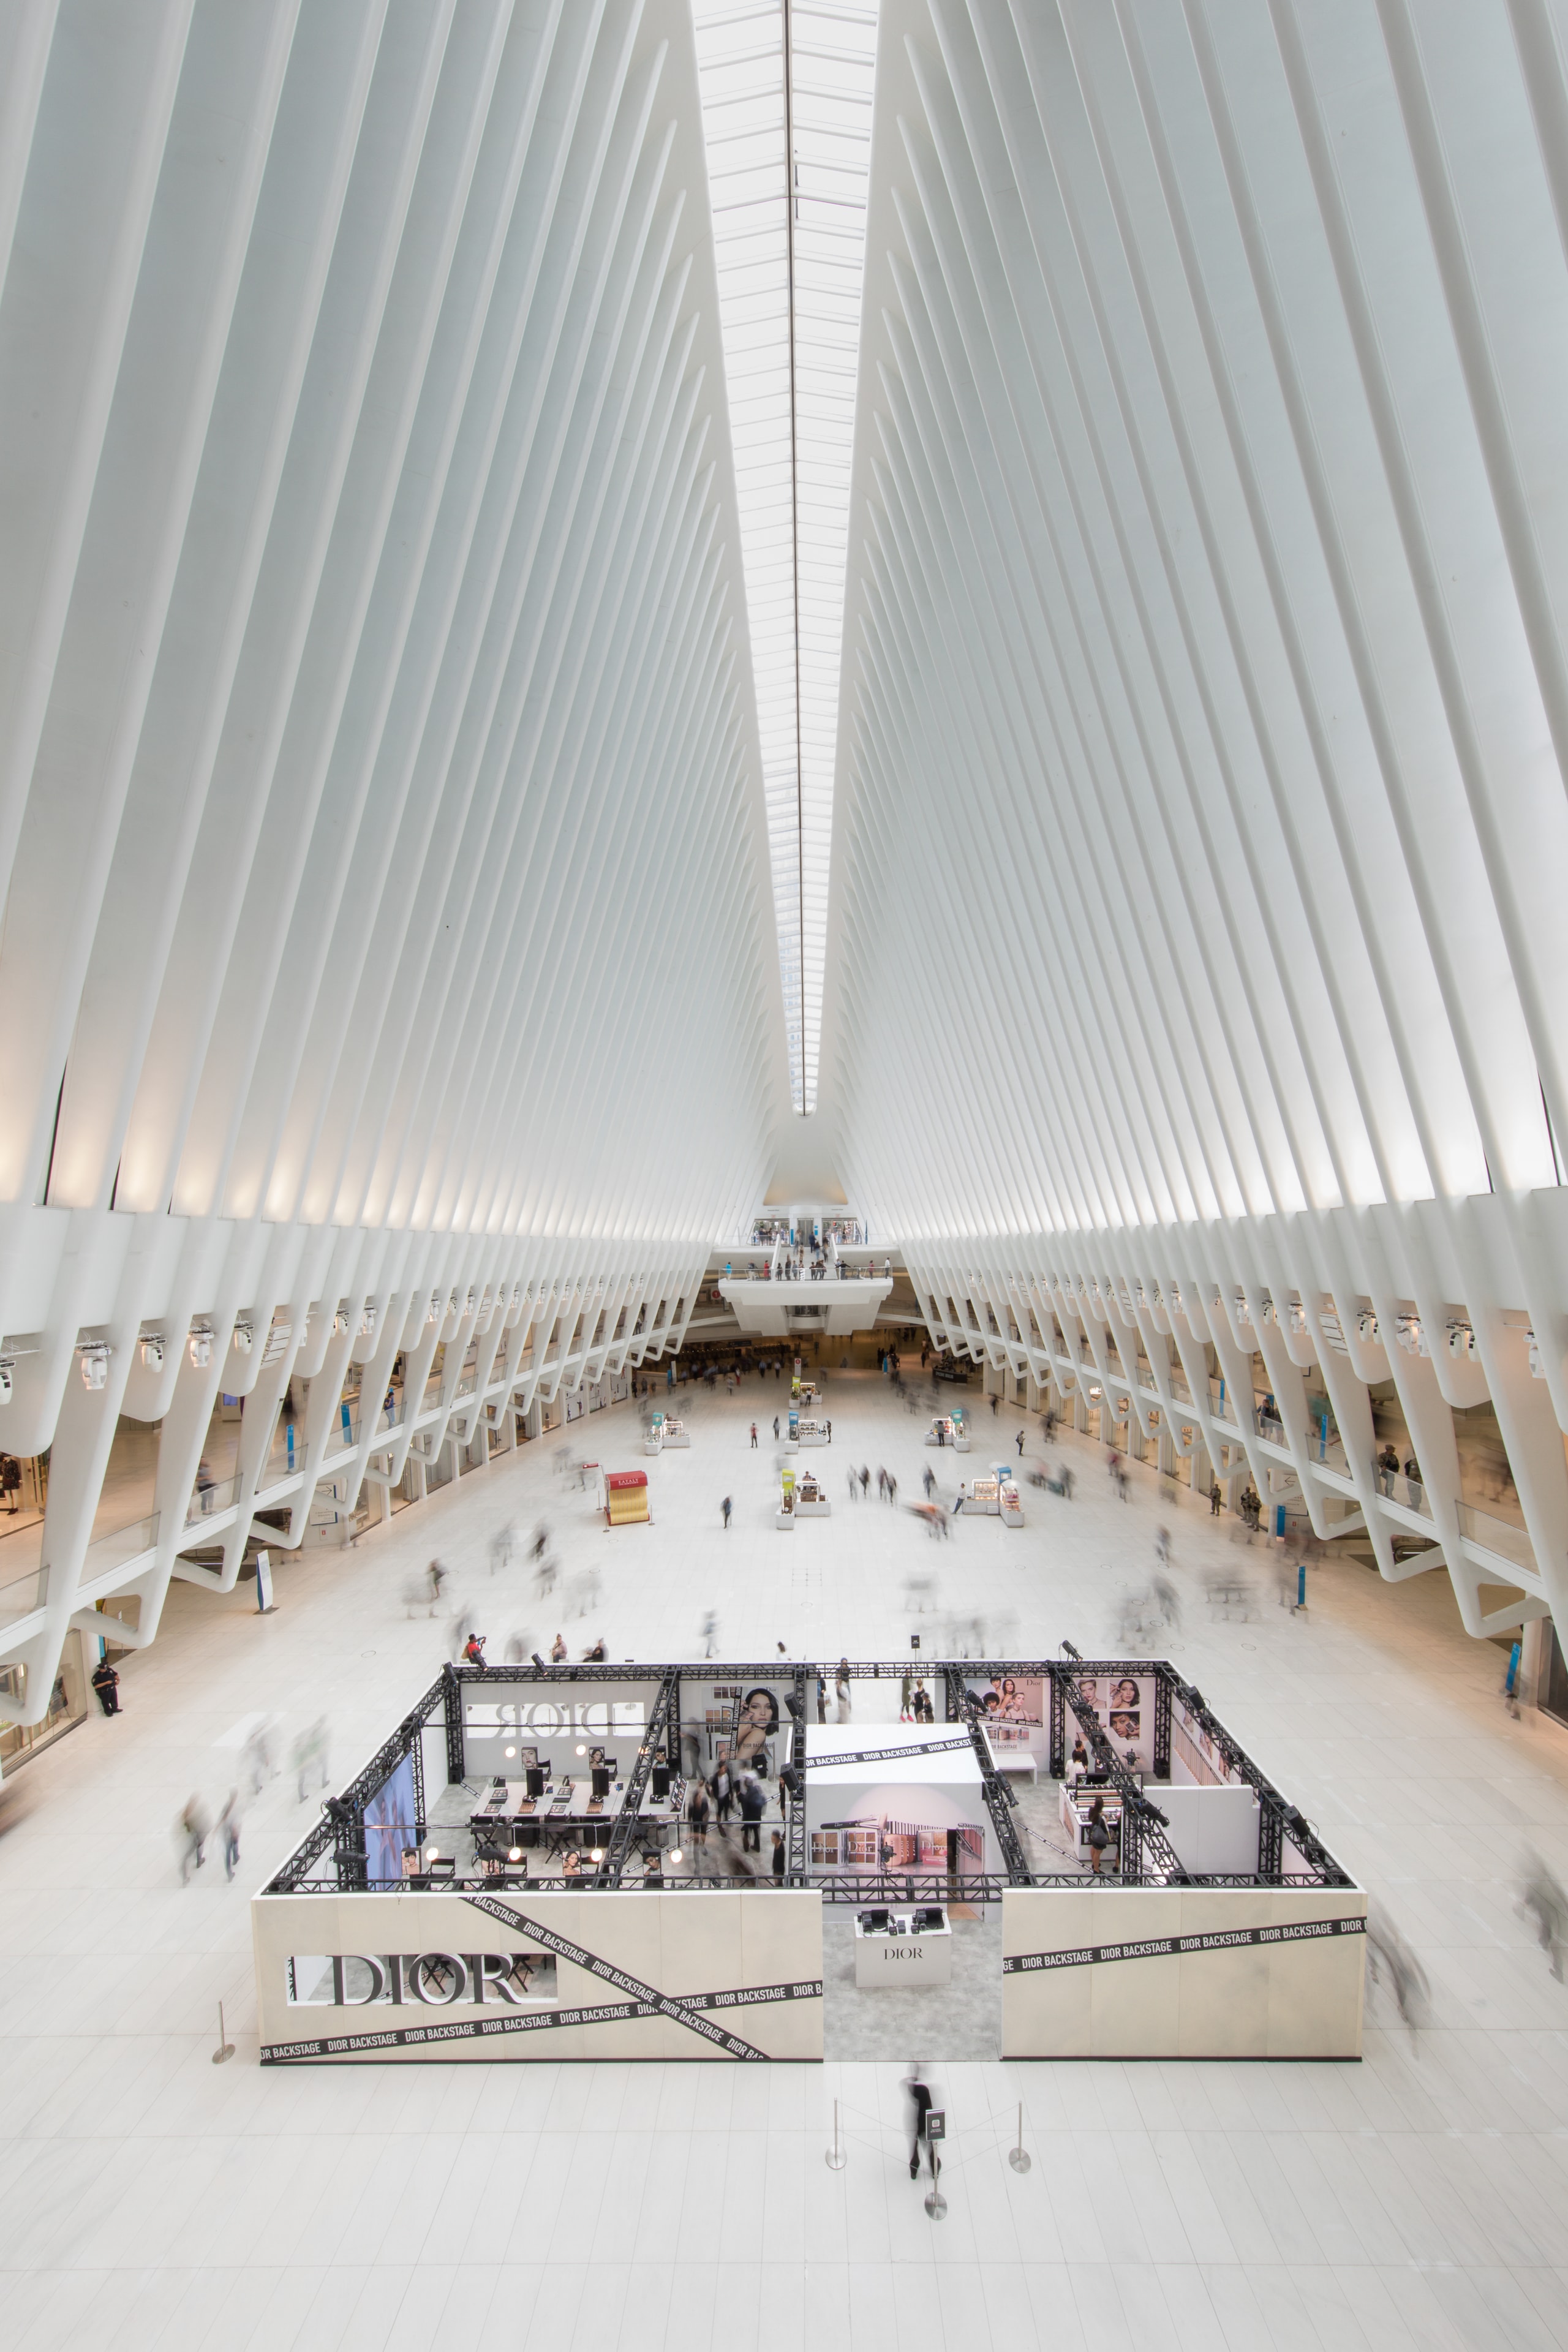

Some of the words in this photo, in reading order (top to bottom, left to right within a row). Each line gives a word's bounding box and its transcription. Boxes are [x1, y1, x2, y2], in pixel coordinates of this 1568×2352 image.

[816, 1755, 858, 1765] BACKSTAGE
[882, 1746, 923, 1758] BACKSTAGE
[813, 1841, 834, 1853] Dior
[848, 1841, 872, 1852] Dior
[922, 1841, 944, 1850] Dior
[884, 1948, 923, 1960] DIOR
[1022, 1958, 1042, 1969] DIOR
[1044, 1951, 1093, 1967] BACKSTAGE
[1101, 1948, 1121, 1960] DIOR
[1123, 1941, 1172, 1956] BACKSTAGE
[1180, 1938, 1201, 1950] DIOR
[1203, 1932, 1252, 1947] BACKSTAGE
[1259, 1929, 1281, 1941] DIOR
[1283, 1923, 1332, 1939] BACKSTAGE
[1341, 1920, 1362, 1932] DIOR
[325, 1953, 522, 2006] DIOR
[474, 1896, 520, 1926] BACKSTAGE
[523, 1921, 545, 1940] DIOR
[543, 1933, 589, 1964] BACKSTAGE
[592, 1961, 613, 1978] DIOR
[611, 1971, 657, 2003] BACKSTAGE
[659, 1999, 680, 2017] DIOR
[679, 2010, 724, 2042] BACKSTAGE
[726, 2038, 748, 2056] DIOR
[273, 2043, 321, 2058] BACKSTAGE
[328, 2040, 349, 2051] DIOR
[350, 2033, 398, 2049] BACKSTAGE
[405, 2030, 426, 2042] DIOR
[427, 2024, 475, 2040] BACKSTAGE
[482, 2022, 503, 2034] DIOR
[504, 2015, 552, 2031] BACKSTAGE
[560, 2012, 581, 2024] DIOR
[582, 2006, 630, 2021] BACKSTAGE
[715, 1994, 736, 2006] DIOR
[737, 1988, 786, 2003] BACKSTAGE
[793, 1984, 814, 1997] DIOR
